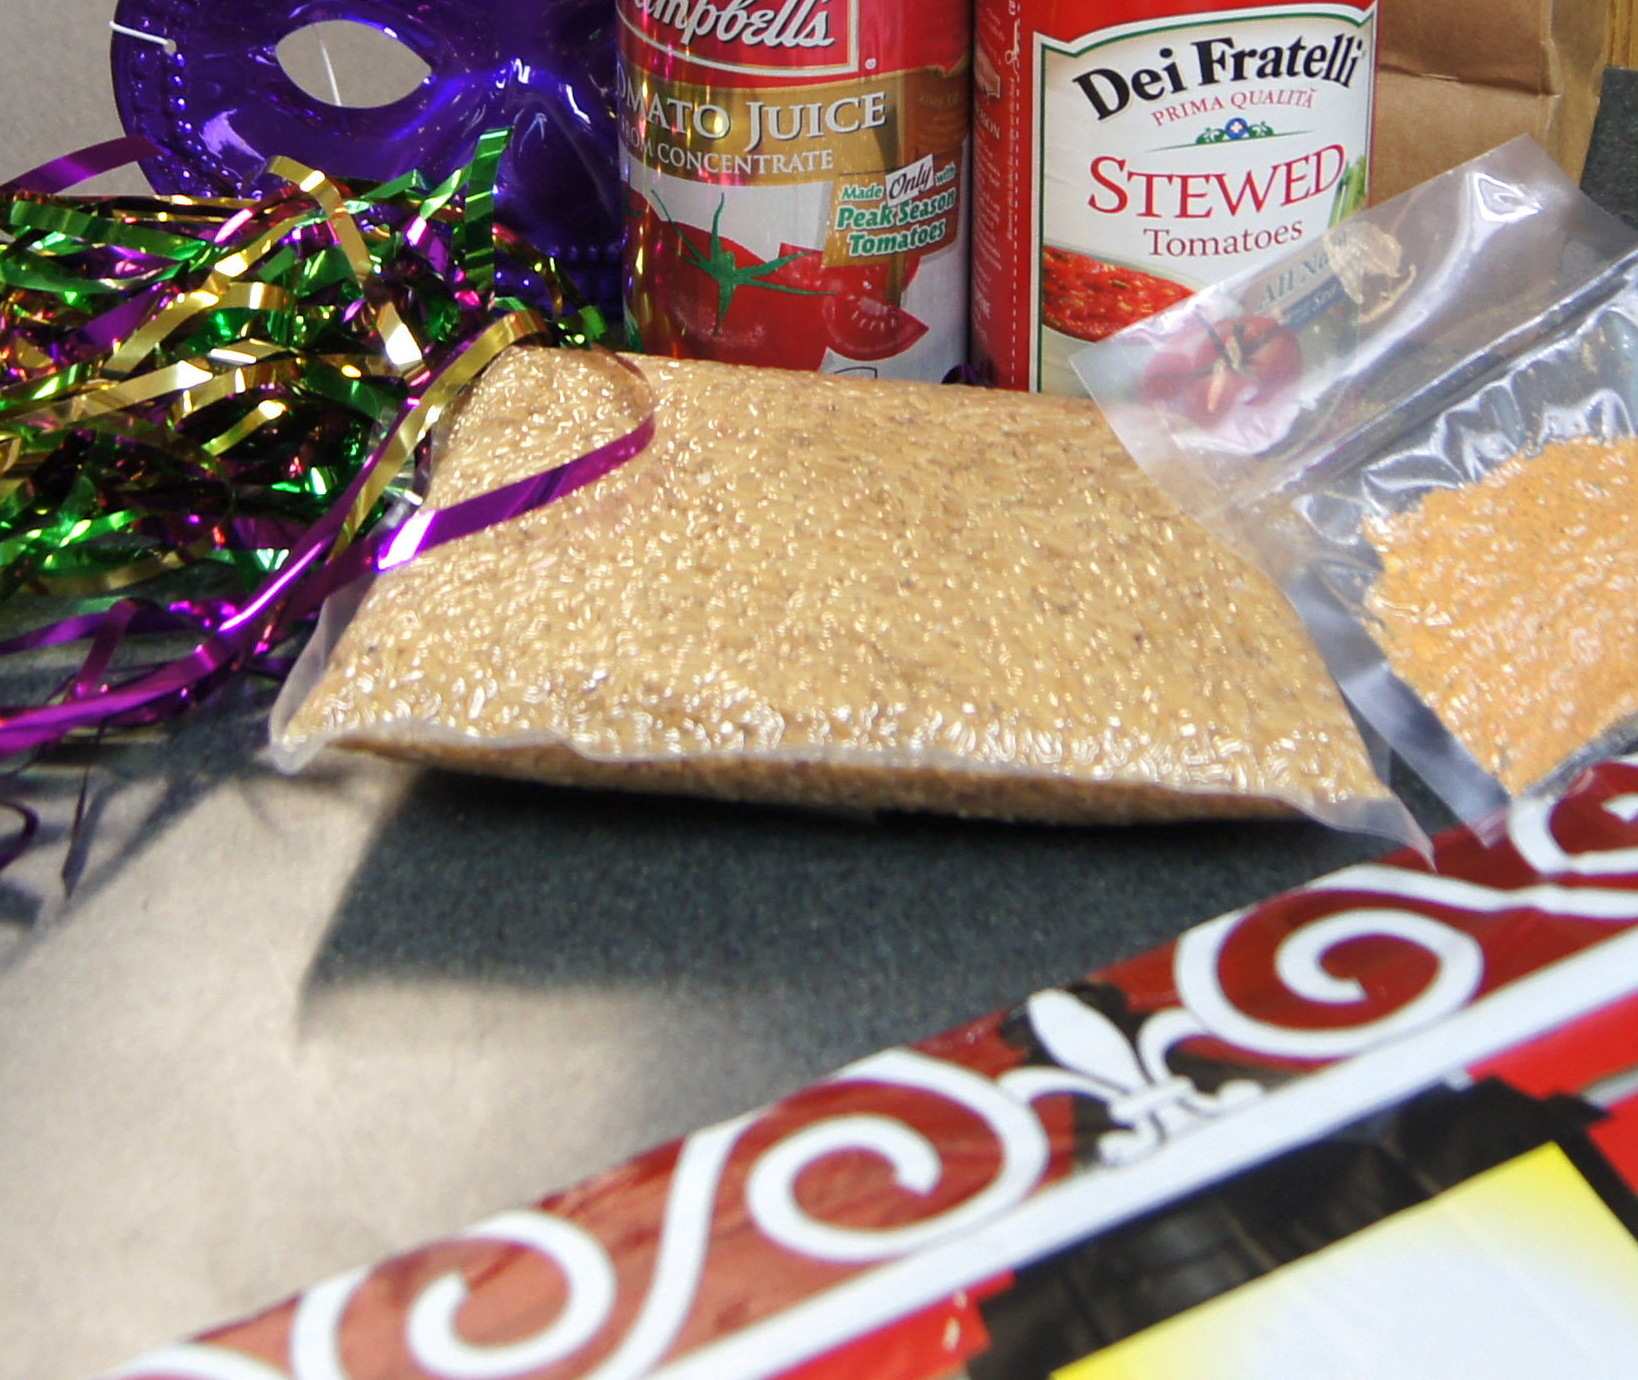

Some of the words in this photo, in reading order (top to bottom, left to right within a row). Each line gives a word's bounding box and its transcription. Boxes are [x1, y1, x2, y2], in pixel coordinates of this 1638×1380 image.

[1072, 47, 1188, 121] Dei
[1190, 33, 1363, 88] Fratelli
[616, 62, 731, 139] OMATO
[744, 91, 887, 152] JUICE
[1151, 96, 1225, 127] PRIMA
[657, 143, 834, 175] CONCENTRATE
[840, 184, 884, 201] Made
[889, 162, 932, 200] Only
[1088, 143, 1346, 219] STEWED
[836, 206, 893, 231] Peak
[895, 189, 956, 226] Season
[849, 219, 946, 257] Tomatoes
[1143, 220, 1303, 258] Tomatoes
